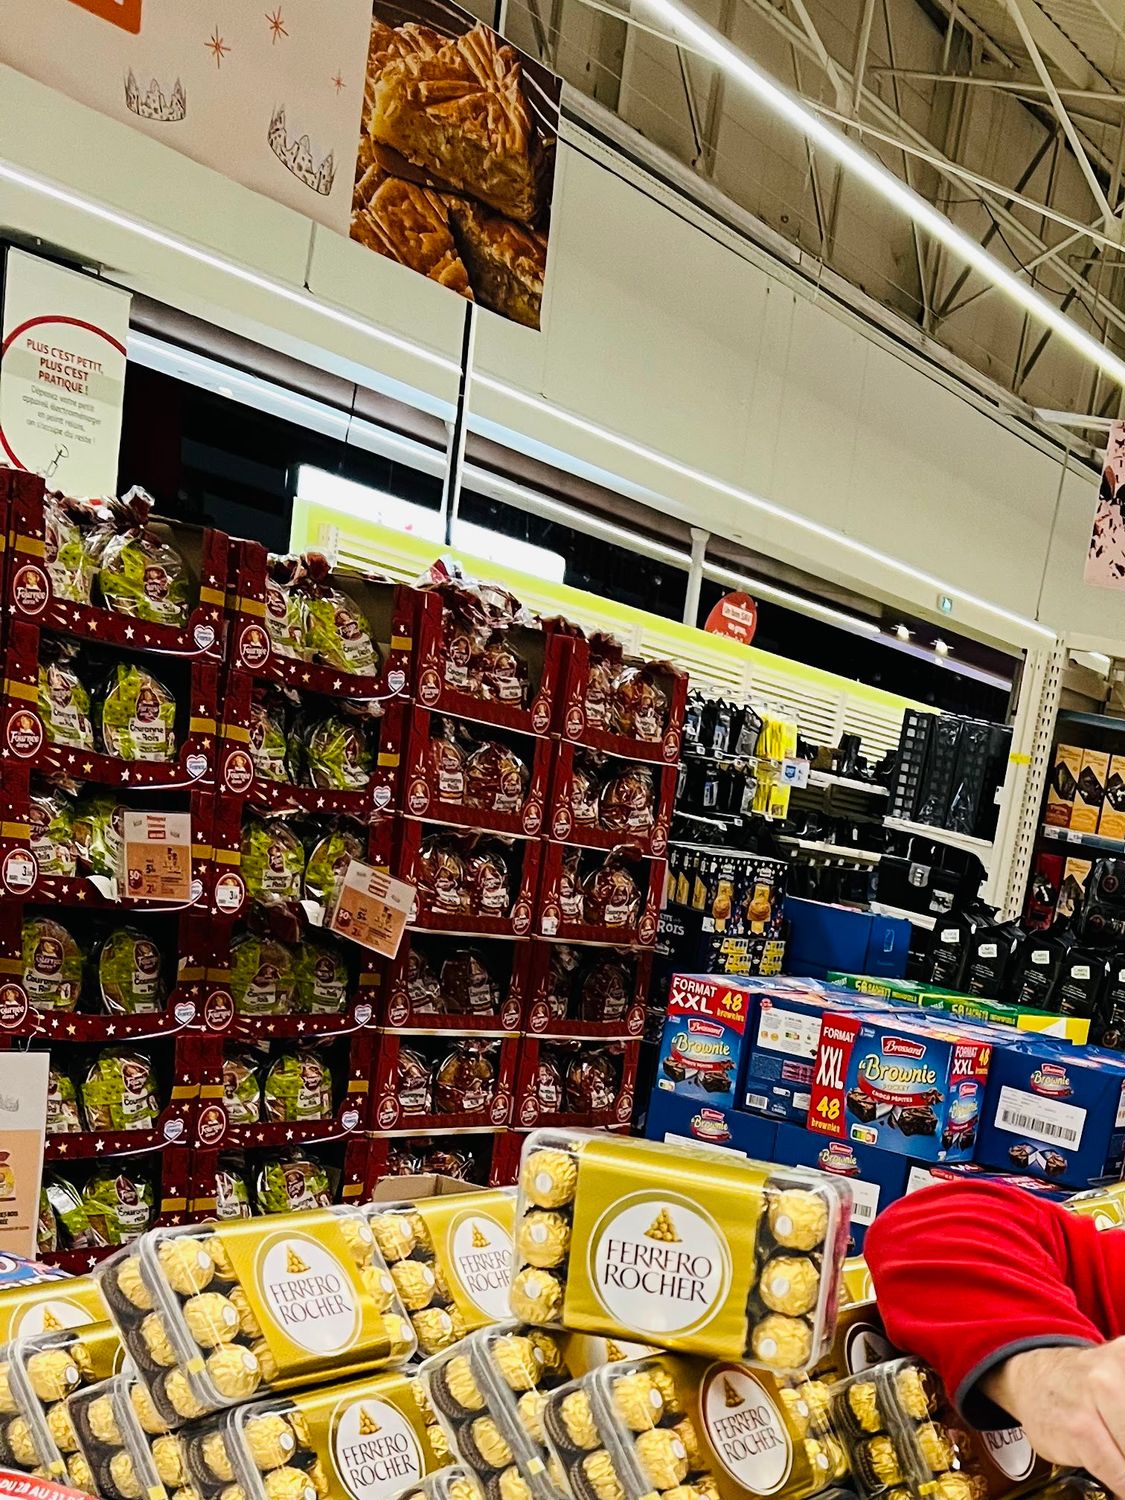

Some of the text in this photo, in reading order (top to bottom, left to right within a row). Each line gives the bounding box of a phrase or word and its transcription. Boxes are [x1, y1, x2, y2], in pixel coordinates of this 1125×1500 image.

[27, 339, 48, 355] PLUS
[51, 347, 76, 363] C'EST
[40, 357, 89, 381] PLUS C'EST
[38, 370, 83, 394] PRATIQUE
[673, 976, 718, 997] FORMAT
[669, 989, 714, 1015] XXL
[721, 991, 743, 1011] 48
[823, 1026, 856, 1043] FORMAT
[883, 1040, 923, 1057] Brossard
[954, 1046, 978, 1058] FORMAT
[816, 1045, 844, 1090] XXL
[864, 1054, 937, 1084] Brownie
[952, 1059, 974, 1075] XXL
[1034, 1070, 1070, 1086] Brownie
[816, 1095, 841, 1120] 48
[811, 1118, 841, 1133] brownies
[607, 1238, 713, 1280] FERRERO
[270, 1273, 342, 1303] FERRERO
[604, 1266, 709, 1305] ROCHER
[278, 1296, 353, 1325] ROCHER
[0, 1477, 14, 1493] DU
[14, 1481, 29, 1495] 28
